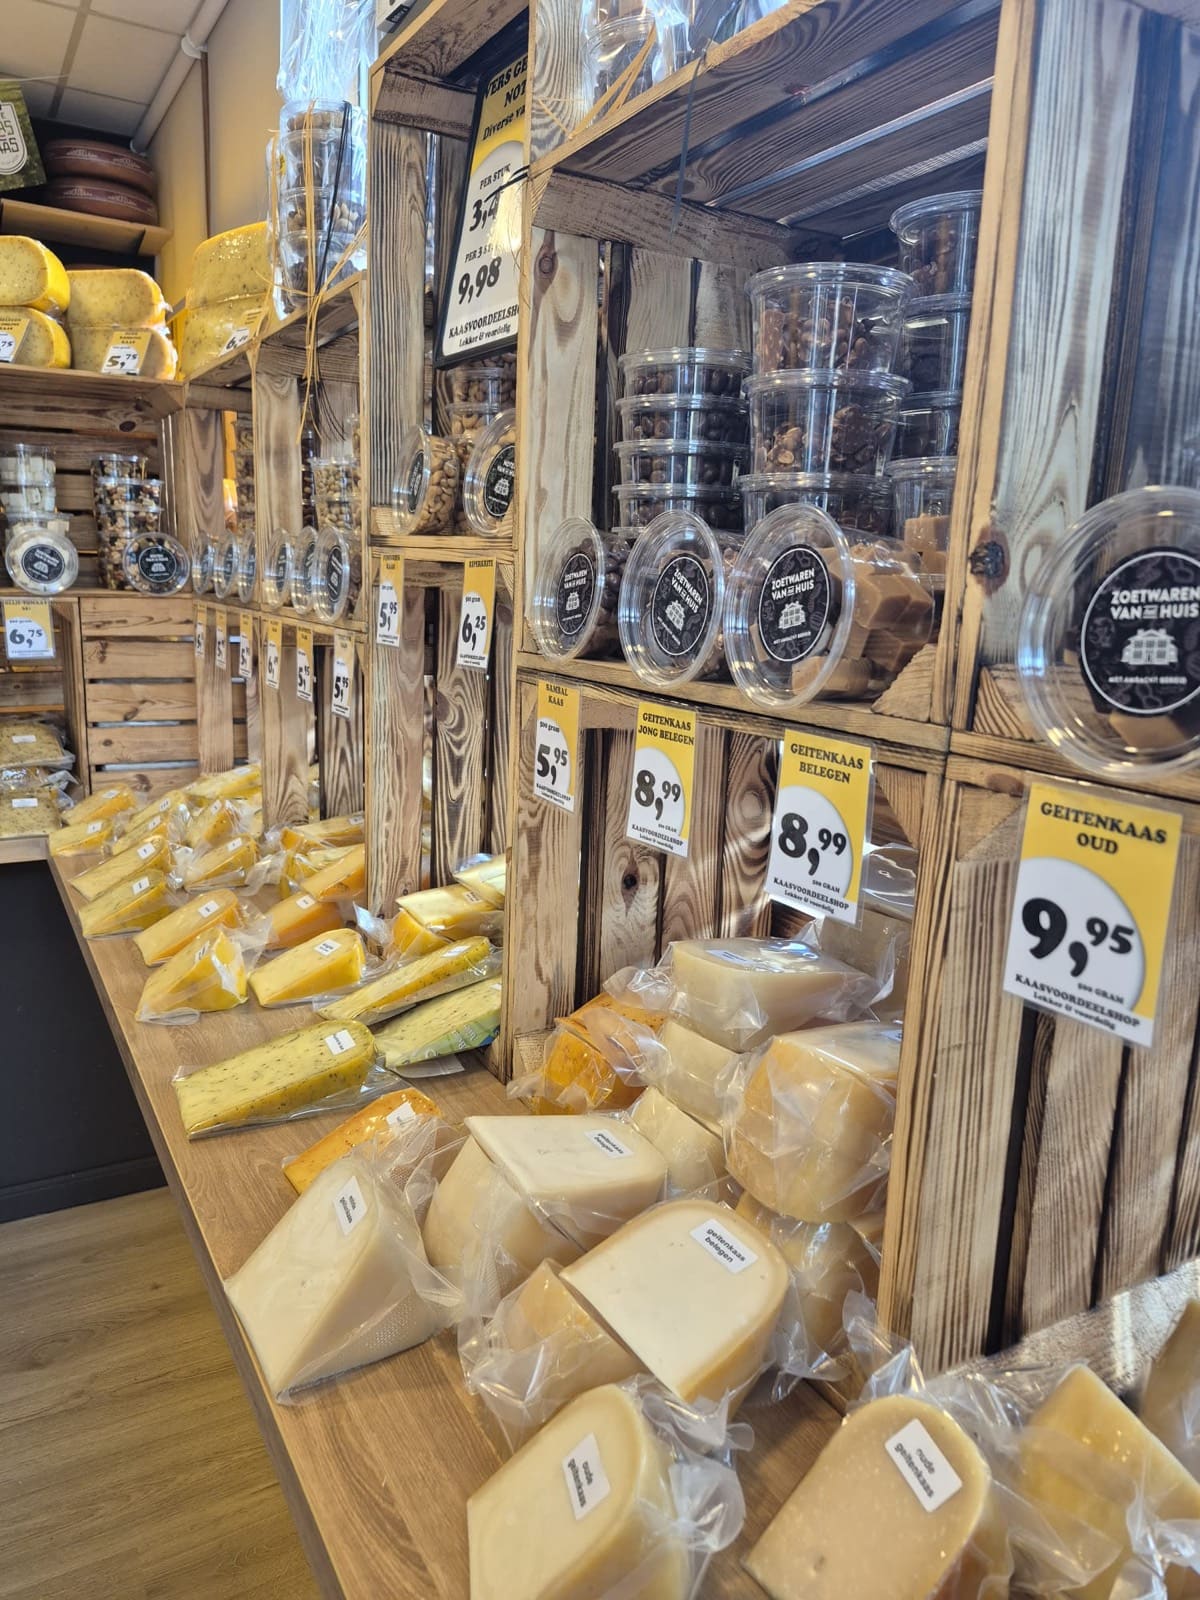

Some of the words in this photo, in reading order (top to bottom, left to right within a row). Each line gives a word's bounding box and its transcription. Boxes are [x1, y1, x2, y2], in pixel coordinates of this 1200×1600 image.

[483, 113, 514, 140] Diverse
[480, 174, 492, 190] PER
[465, 249, 477, 263] PER
[458, 256, 502, 305] 9,98
[106, 353, 138, 369] 5,75
[771, 568, 815, 590] ZOETWAREN
[771, 588, 787, 600] VAN
[795, 579, 815, 594] HUIS
[1110, 586, 1200, 604] ZOETWAREN
[379, 602, 398, 632] 5,95
[1110, 604, 1142, 620] VAN
[1159, 603, 1199, 618] HUIS
[10, 629, 43, 649] 6,75
[462, 613, 487, 651] 6,25
[334, 675, 349, 703] 5,95
[545, 683, 568, 697] SAMBAL
[548, 695, 564, 707] KAAS
[638, 724, 658, 738] JONG
[659, 730, 695, 746] BELEGEN
[642, 712, 691, 731] GEITENKAAS
[536, 744, 568, 786] 5,95
[789, 743, 864, 770] GEITENKAAS
[798, 761, 851, 784] BELEGEN
[634, 769, 681, 821] 8,99
[1040, 802, 1167, 844] GEITENKAAS
[778, 812, 847, 876] 8,99
[1076, 832, 1118, 855] OUD
[772, 877, 850, 911] KAASVOORDEELSHOP
[822, 881, 841, 894] GRAM
[1021, 897, 1135, 978] 9,95
[1015, 973, 1141, 1028] KAASVOORDEELSHOP
[1094, 987, 1124, 1004] GRAM
[704, 1236, 733, 1263] belegen
[706, 1228, 746, 1262] geitenkaas
[582, 1460, 594, 1485] oude
[893, 1442, 934, 1498] geitenkaas
[916, 1447, 935, 1474] oude
[567, 1458, 587, 1508] geitenkaas
